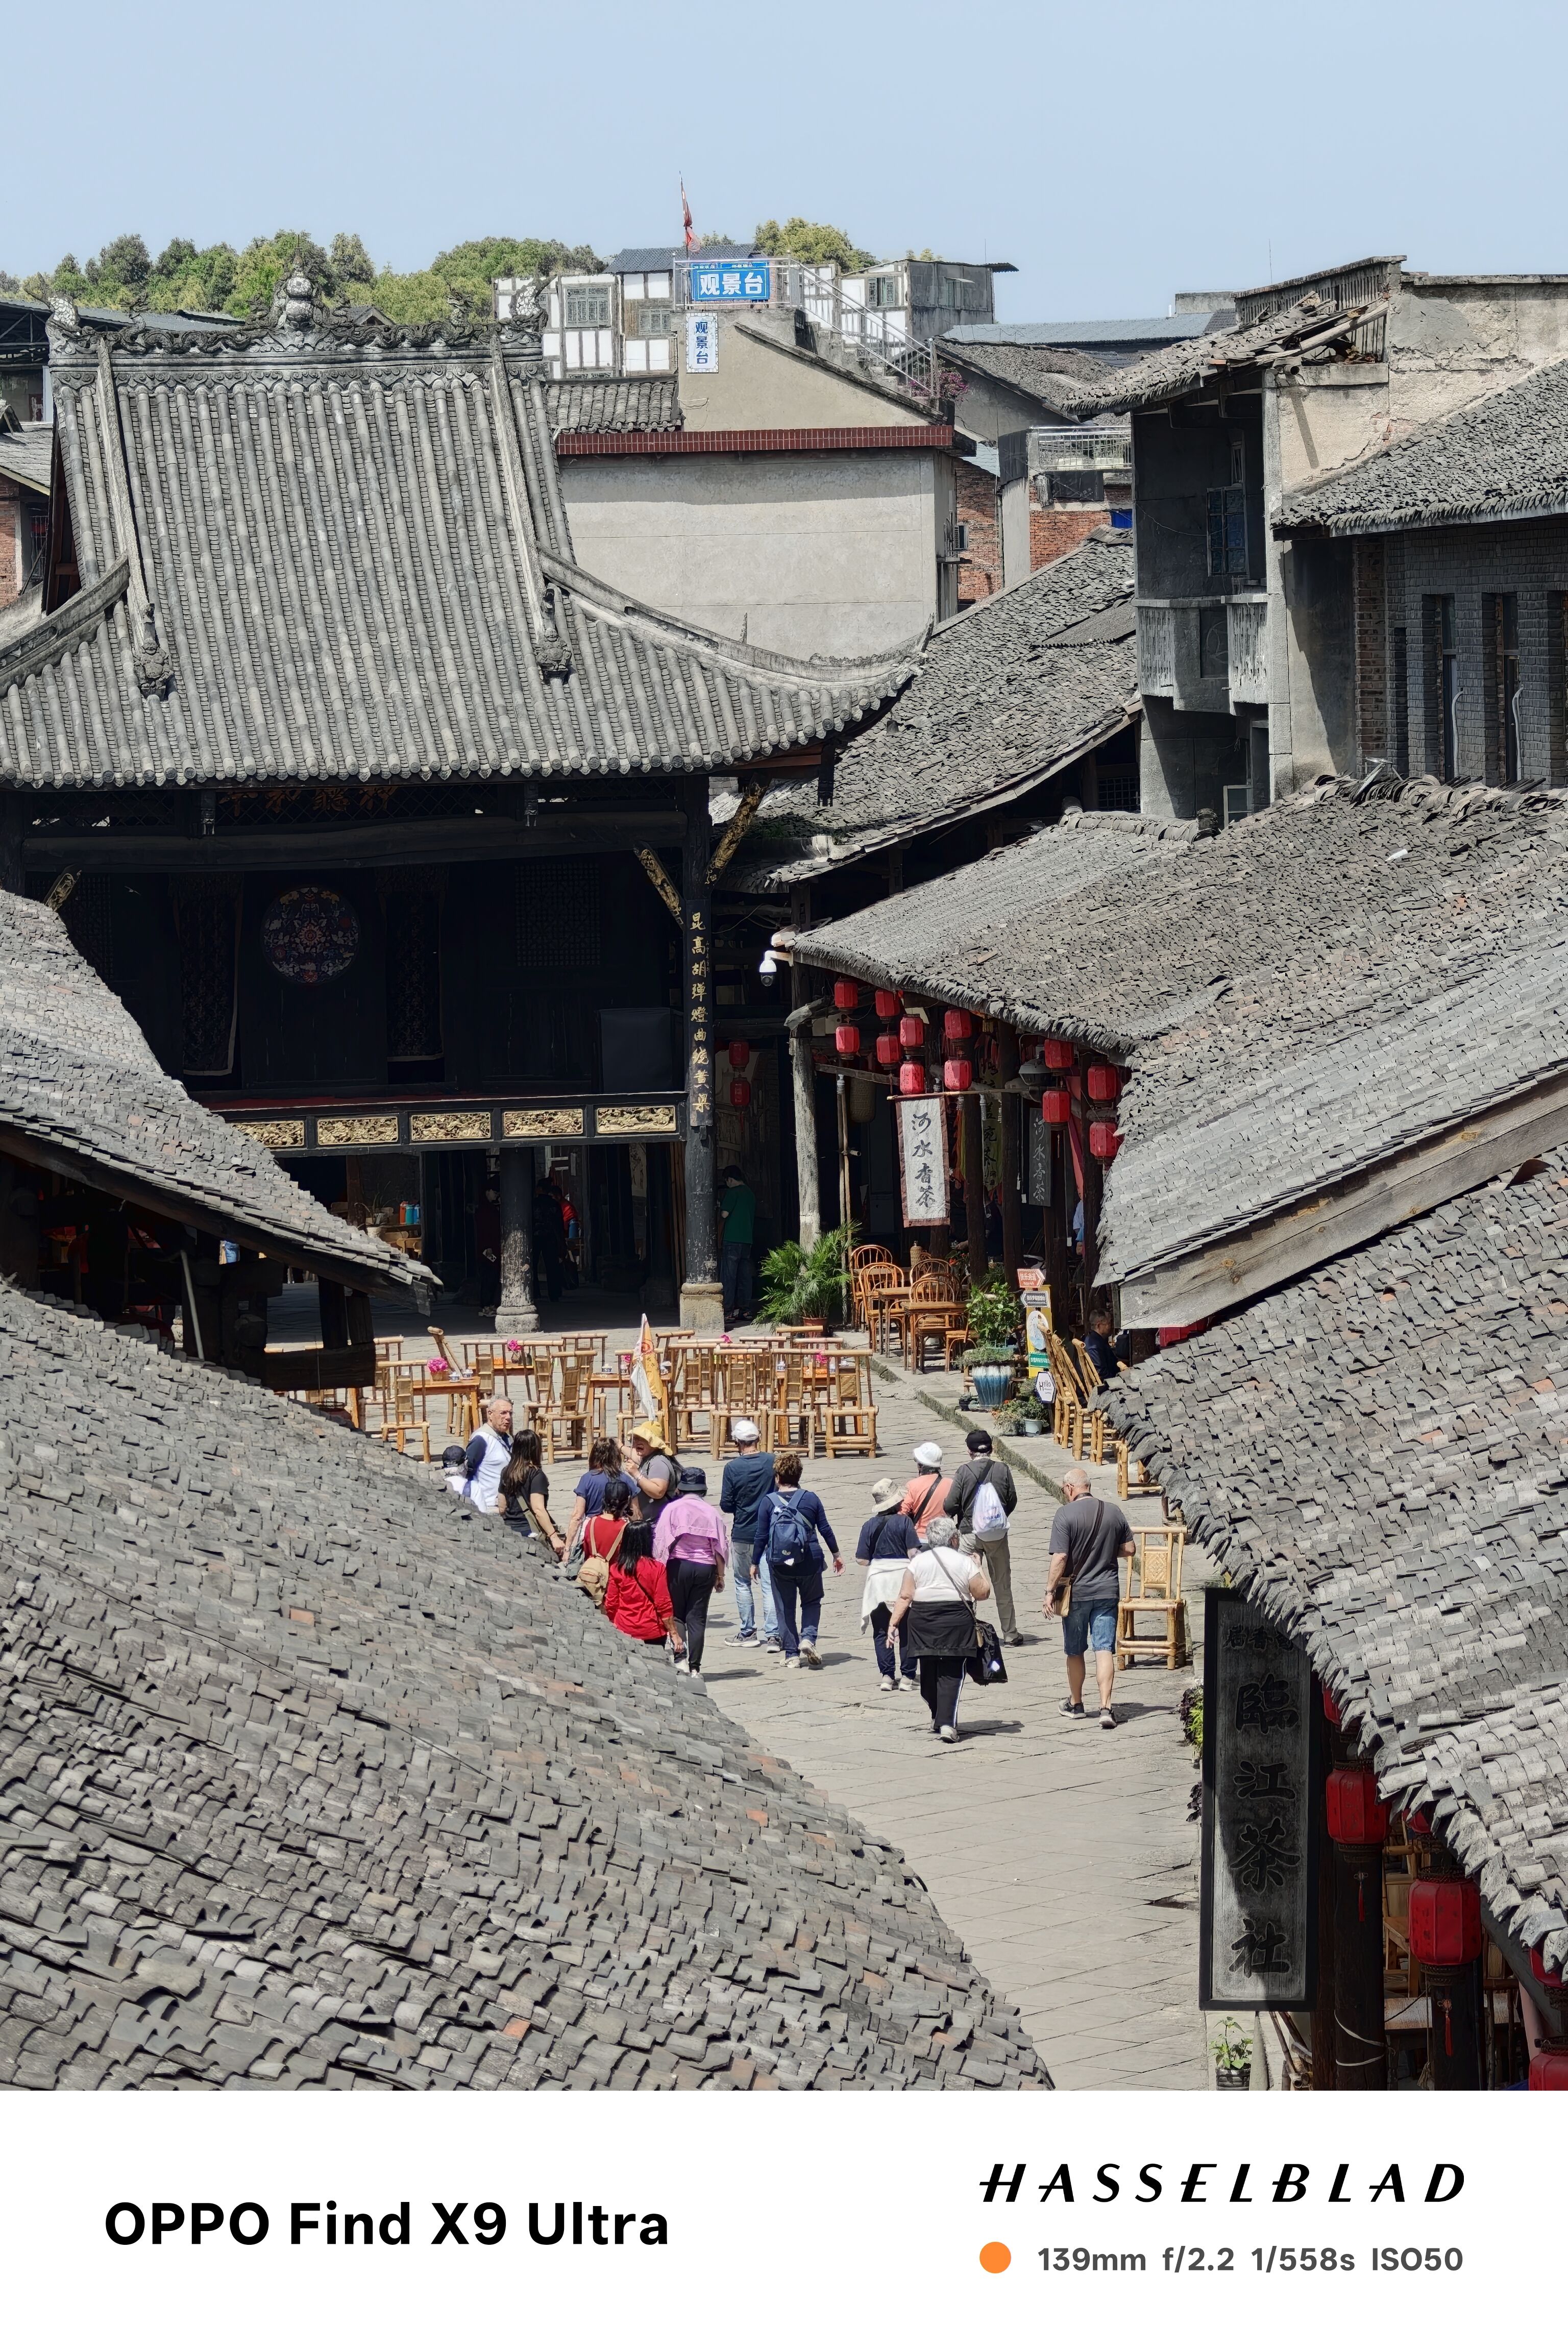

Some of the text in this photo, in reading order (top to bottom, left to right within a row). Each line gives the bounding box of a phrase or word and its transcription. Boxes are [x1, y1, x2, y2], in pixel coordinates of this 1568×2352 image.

[700, 272, 763, 296] 观景台
[695, 321, 709, 364] 观景台
[1039, 1381, 1051, 1392] Hello
[1229, 1673, 1301, 1979] 臨江茶社
